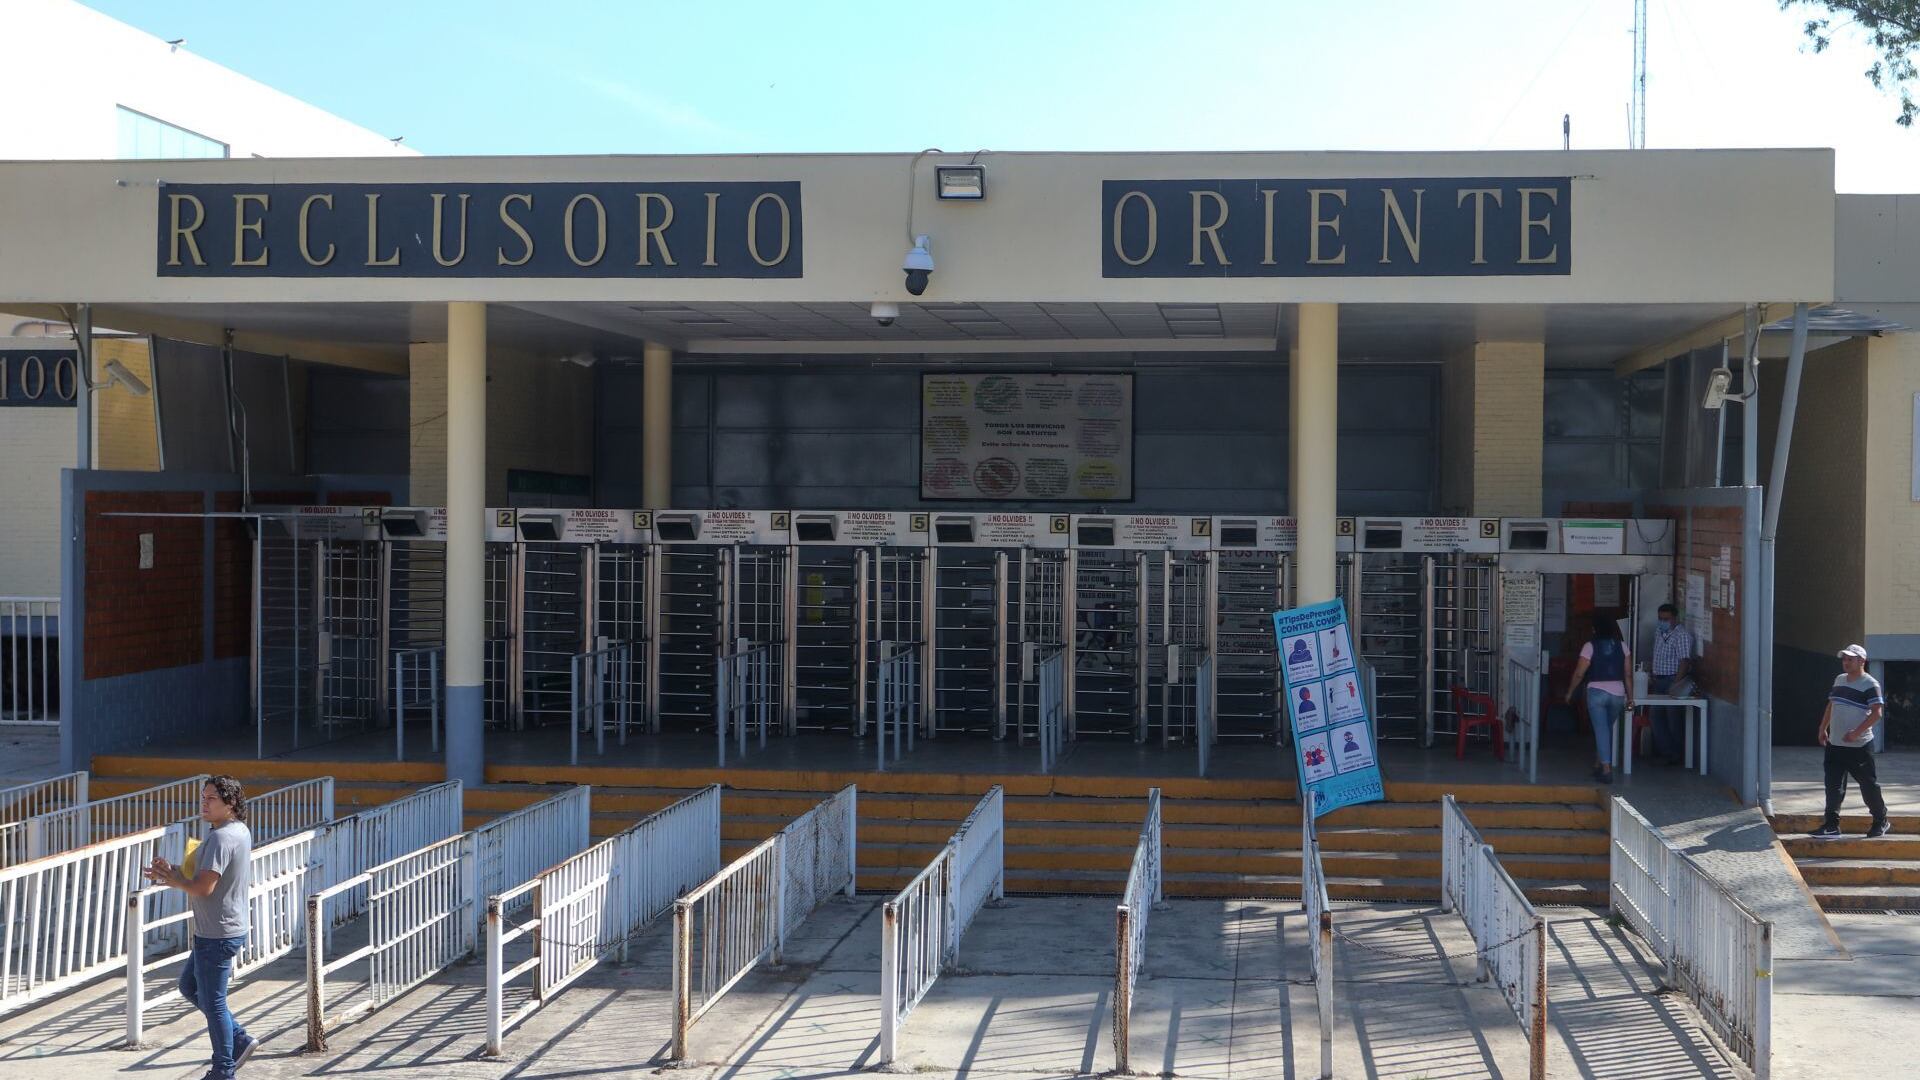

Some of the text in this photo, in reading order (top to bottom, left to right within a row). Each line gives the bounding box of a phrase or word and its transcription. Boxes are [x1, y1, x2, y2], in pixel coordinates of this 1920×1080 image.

[166, 187, 1559, 268] RECLUSORIO ORIENTE
[501, 512, 512, 524] 2
[637, 514, 648, 527] 3
[775, 515, 785, 528] 4
[914, 516, 925, 530] 5
[1054, 518, 1065, 531] 6
[1196, 521, 1207, 534] 7
[1340, 520, 1352, 534] 8
[1483, 522, 1495, 536] 9
[1279, 605, 1342, 625] #TipsDePreven
[1281, 622, 1314, 634] CONTRA
